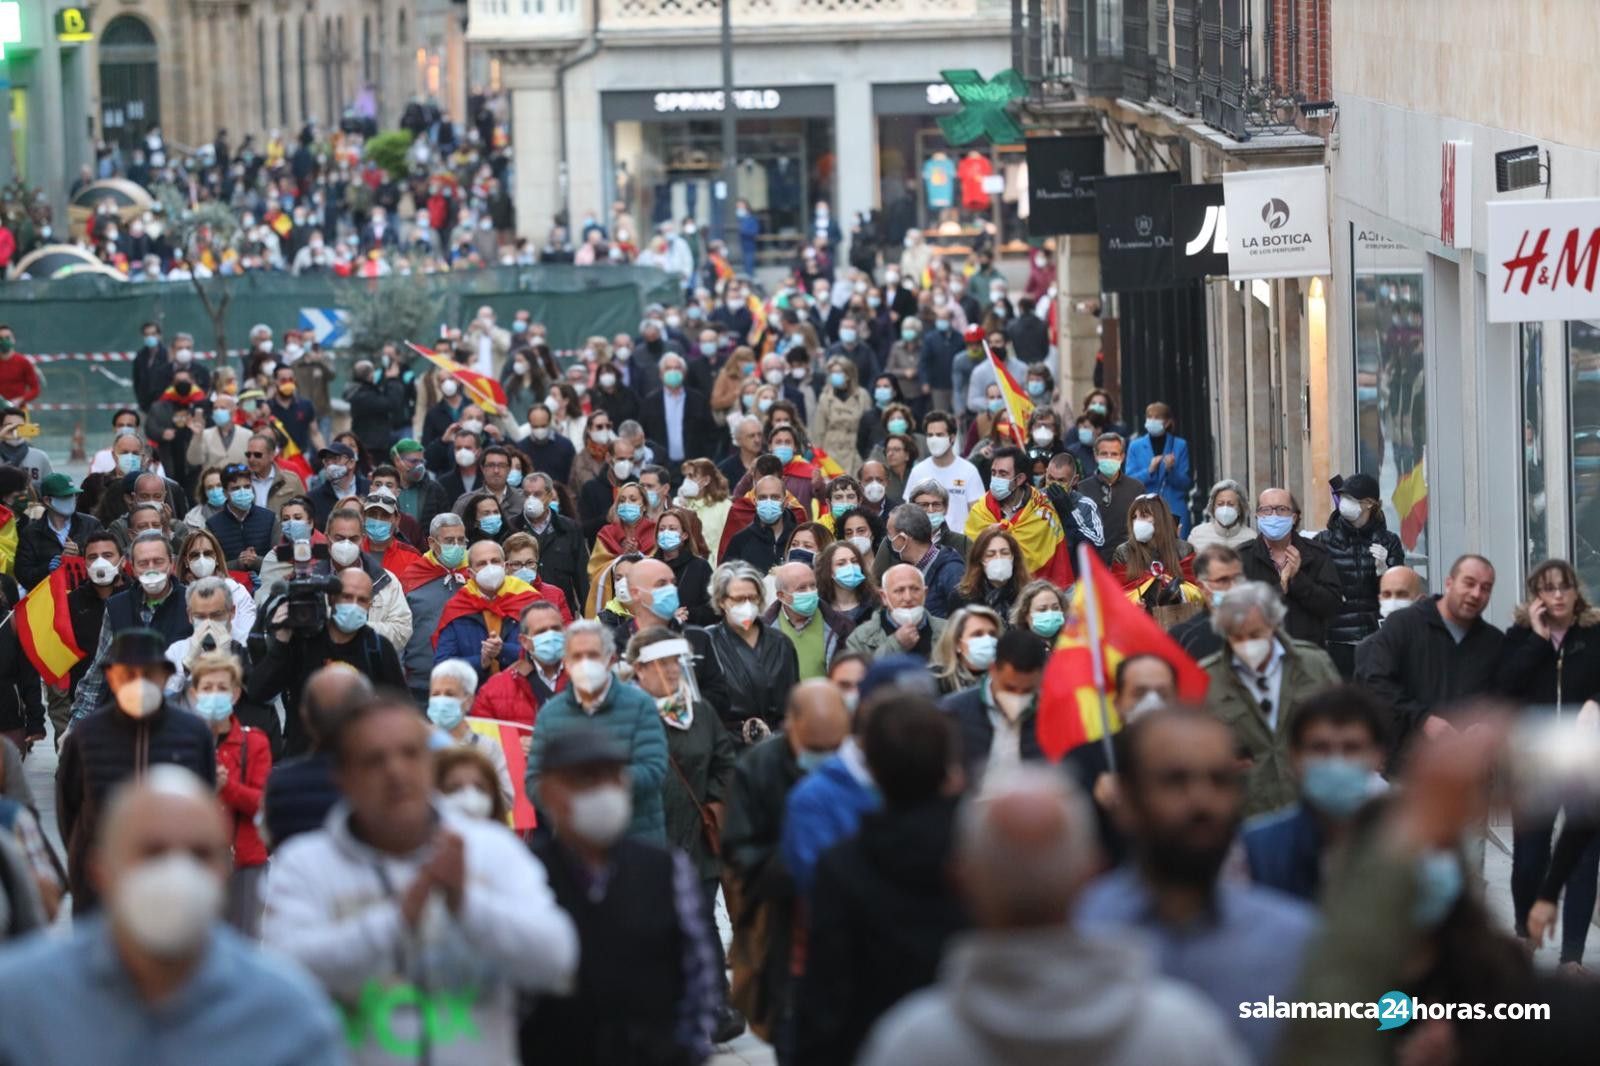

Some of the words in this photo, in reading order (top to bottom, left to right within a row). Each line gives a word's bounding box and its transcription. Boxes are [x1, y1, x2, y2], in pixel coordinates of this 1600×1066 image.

[654, 89, 780, 112] SPRINGIELD
[1242, 237, 1259, 248] LA
[1262, 233, 1312, 246] BOTICA
[1272, 246, 1305, 254] PERFUMES
[1502, 227, 1600, 295] H&M
